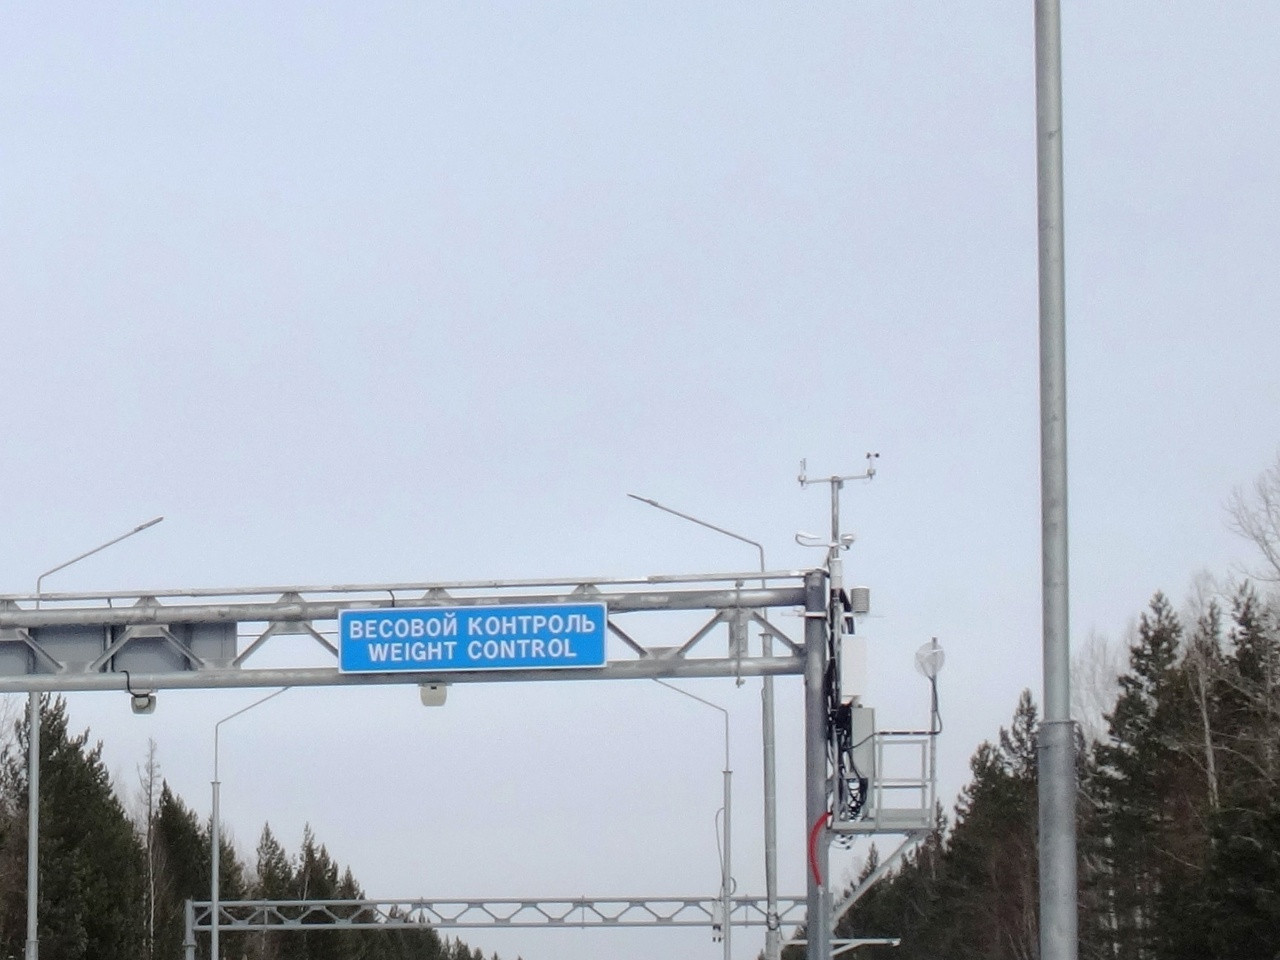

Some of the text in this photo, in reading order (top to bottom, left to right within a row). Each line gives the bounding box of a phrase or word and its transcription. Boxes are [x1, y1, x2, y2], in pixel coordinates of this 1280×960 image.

[349, 612, 595, 639] ВЕСОВОЙ КОНТРОЛЬ
[368, 638, 578, 662] WEIGHT CONTROL
